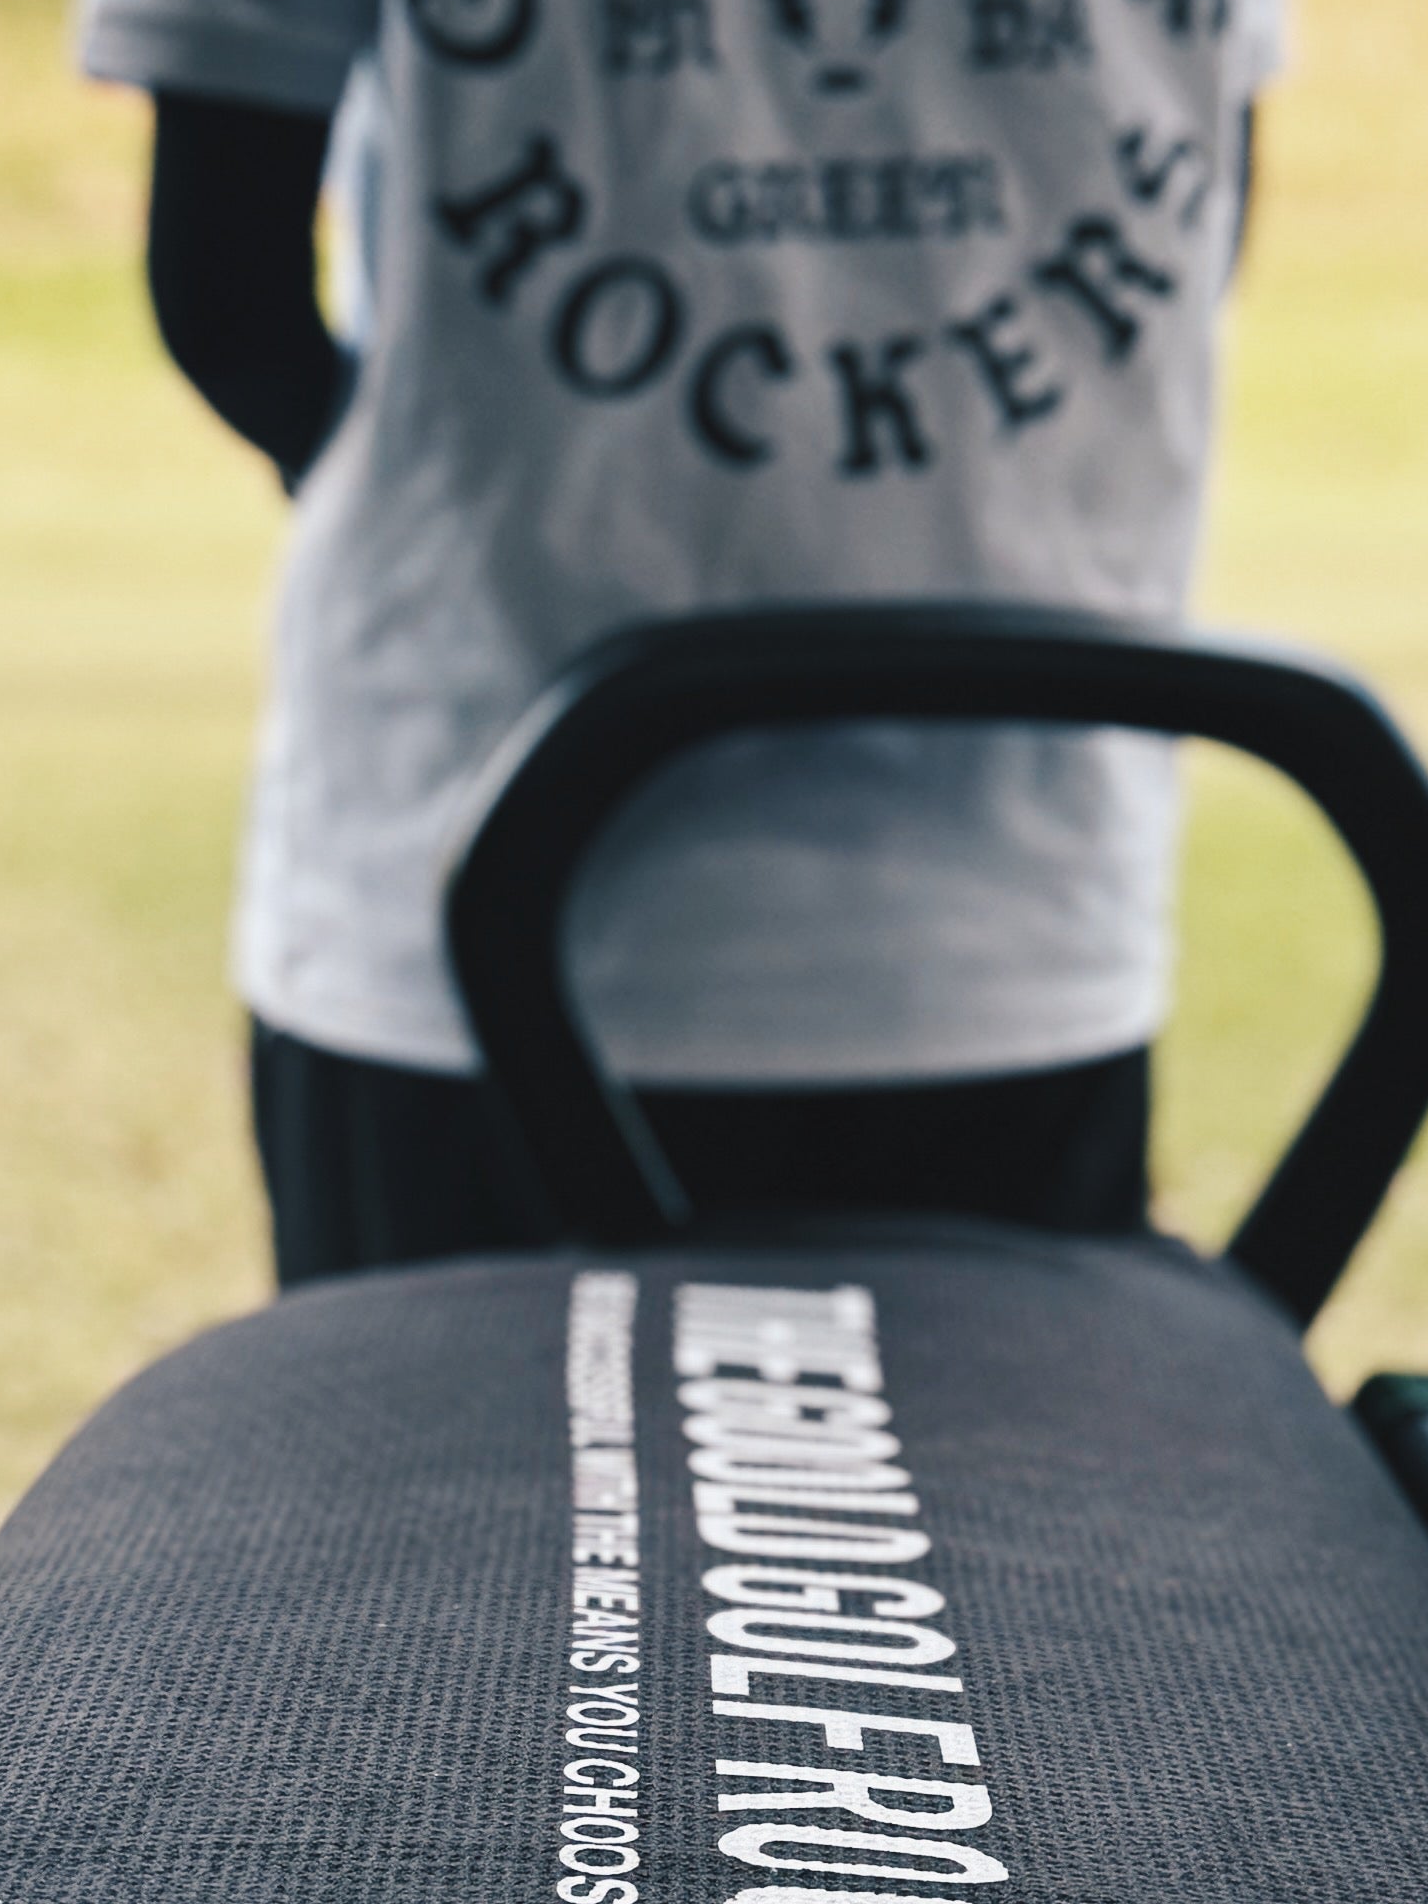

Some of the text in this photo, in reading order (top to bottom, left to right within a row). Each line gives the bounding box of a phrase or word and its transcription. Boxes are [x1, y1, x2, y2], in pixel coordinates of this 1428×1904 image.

[436, 124, 1210, 480] ROCKERS
[572, 1512, 640, 1567] THE
[570, 1566, 640, 1673] MEANS
[565, 1682, 640, 1754] YOU
